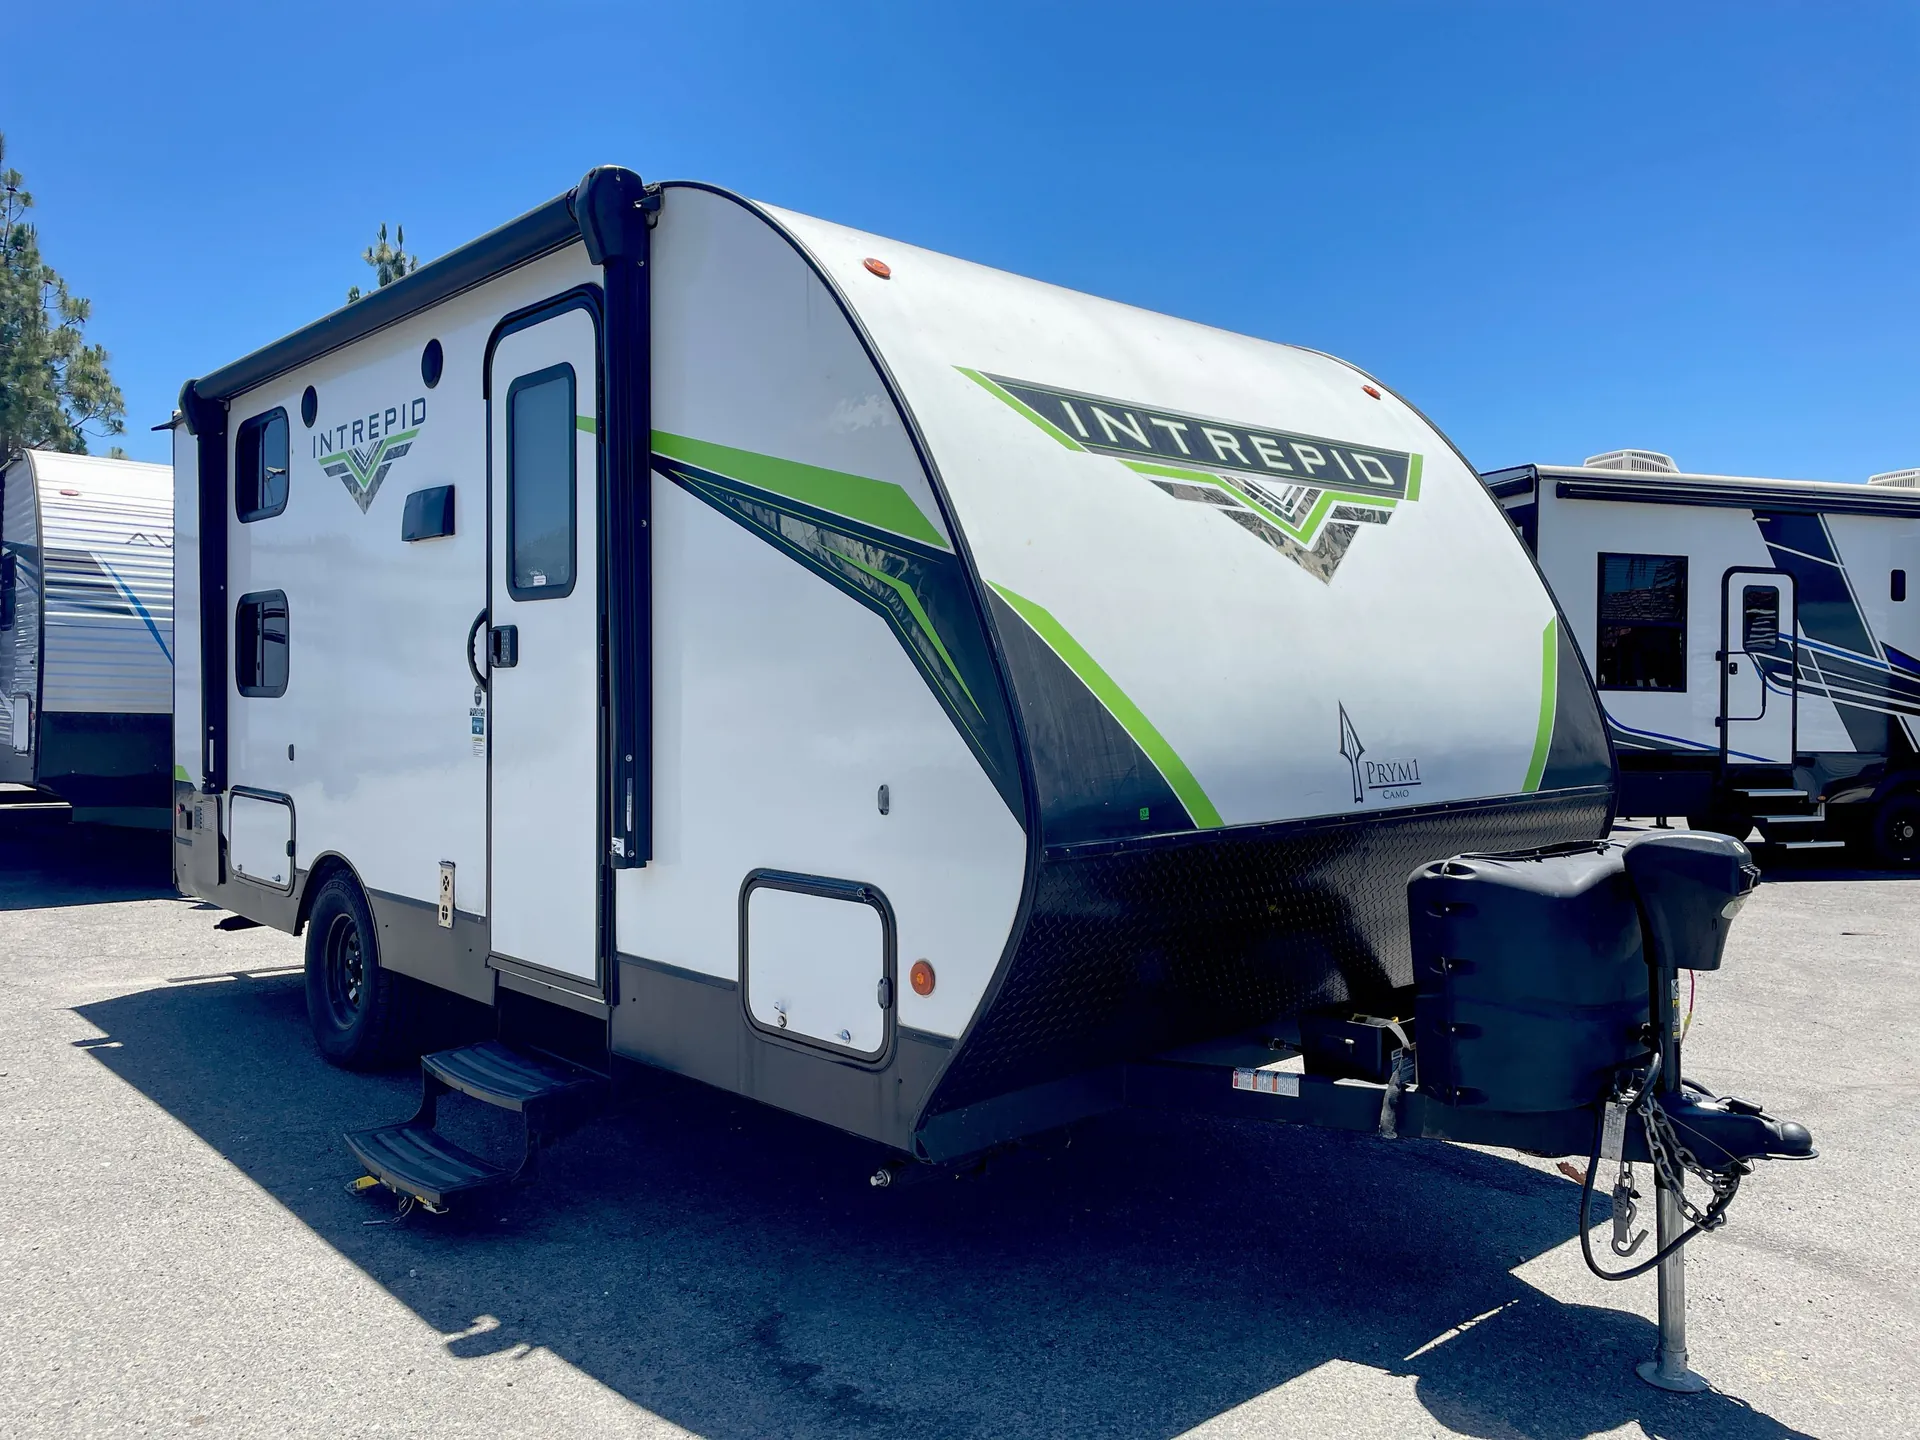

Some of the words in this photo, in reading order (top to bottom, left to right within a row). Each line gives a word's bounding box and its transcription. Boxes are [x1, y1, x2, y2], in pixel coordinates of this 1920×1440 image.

[312, 397, 426, 459] INTREPID
[1060, 400, 1395, 486] INTREPID
[1365, 758, 1421, 784] PRYM1
